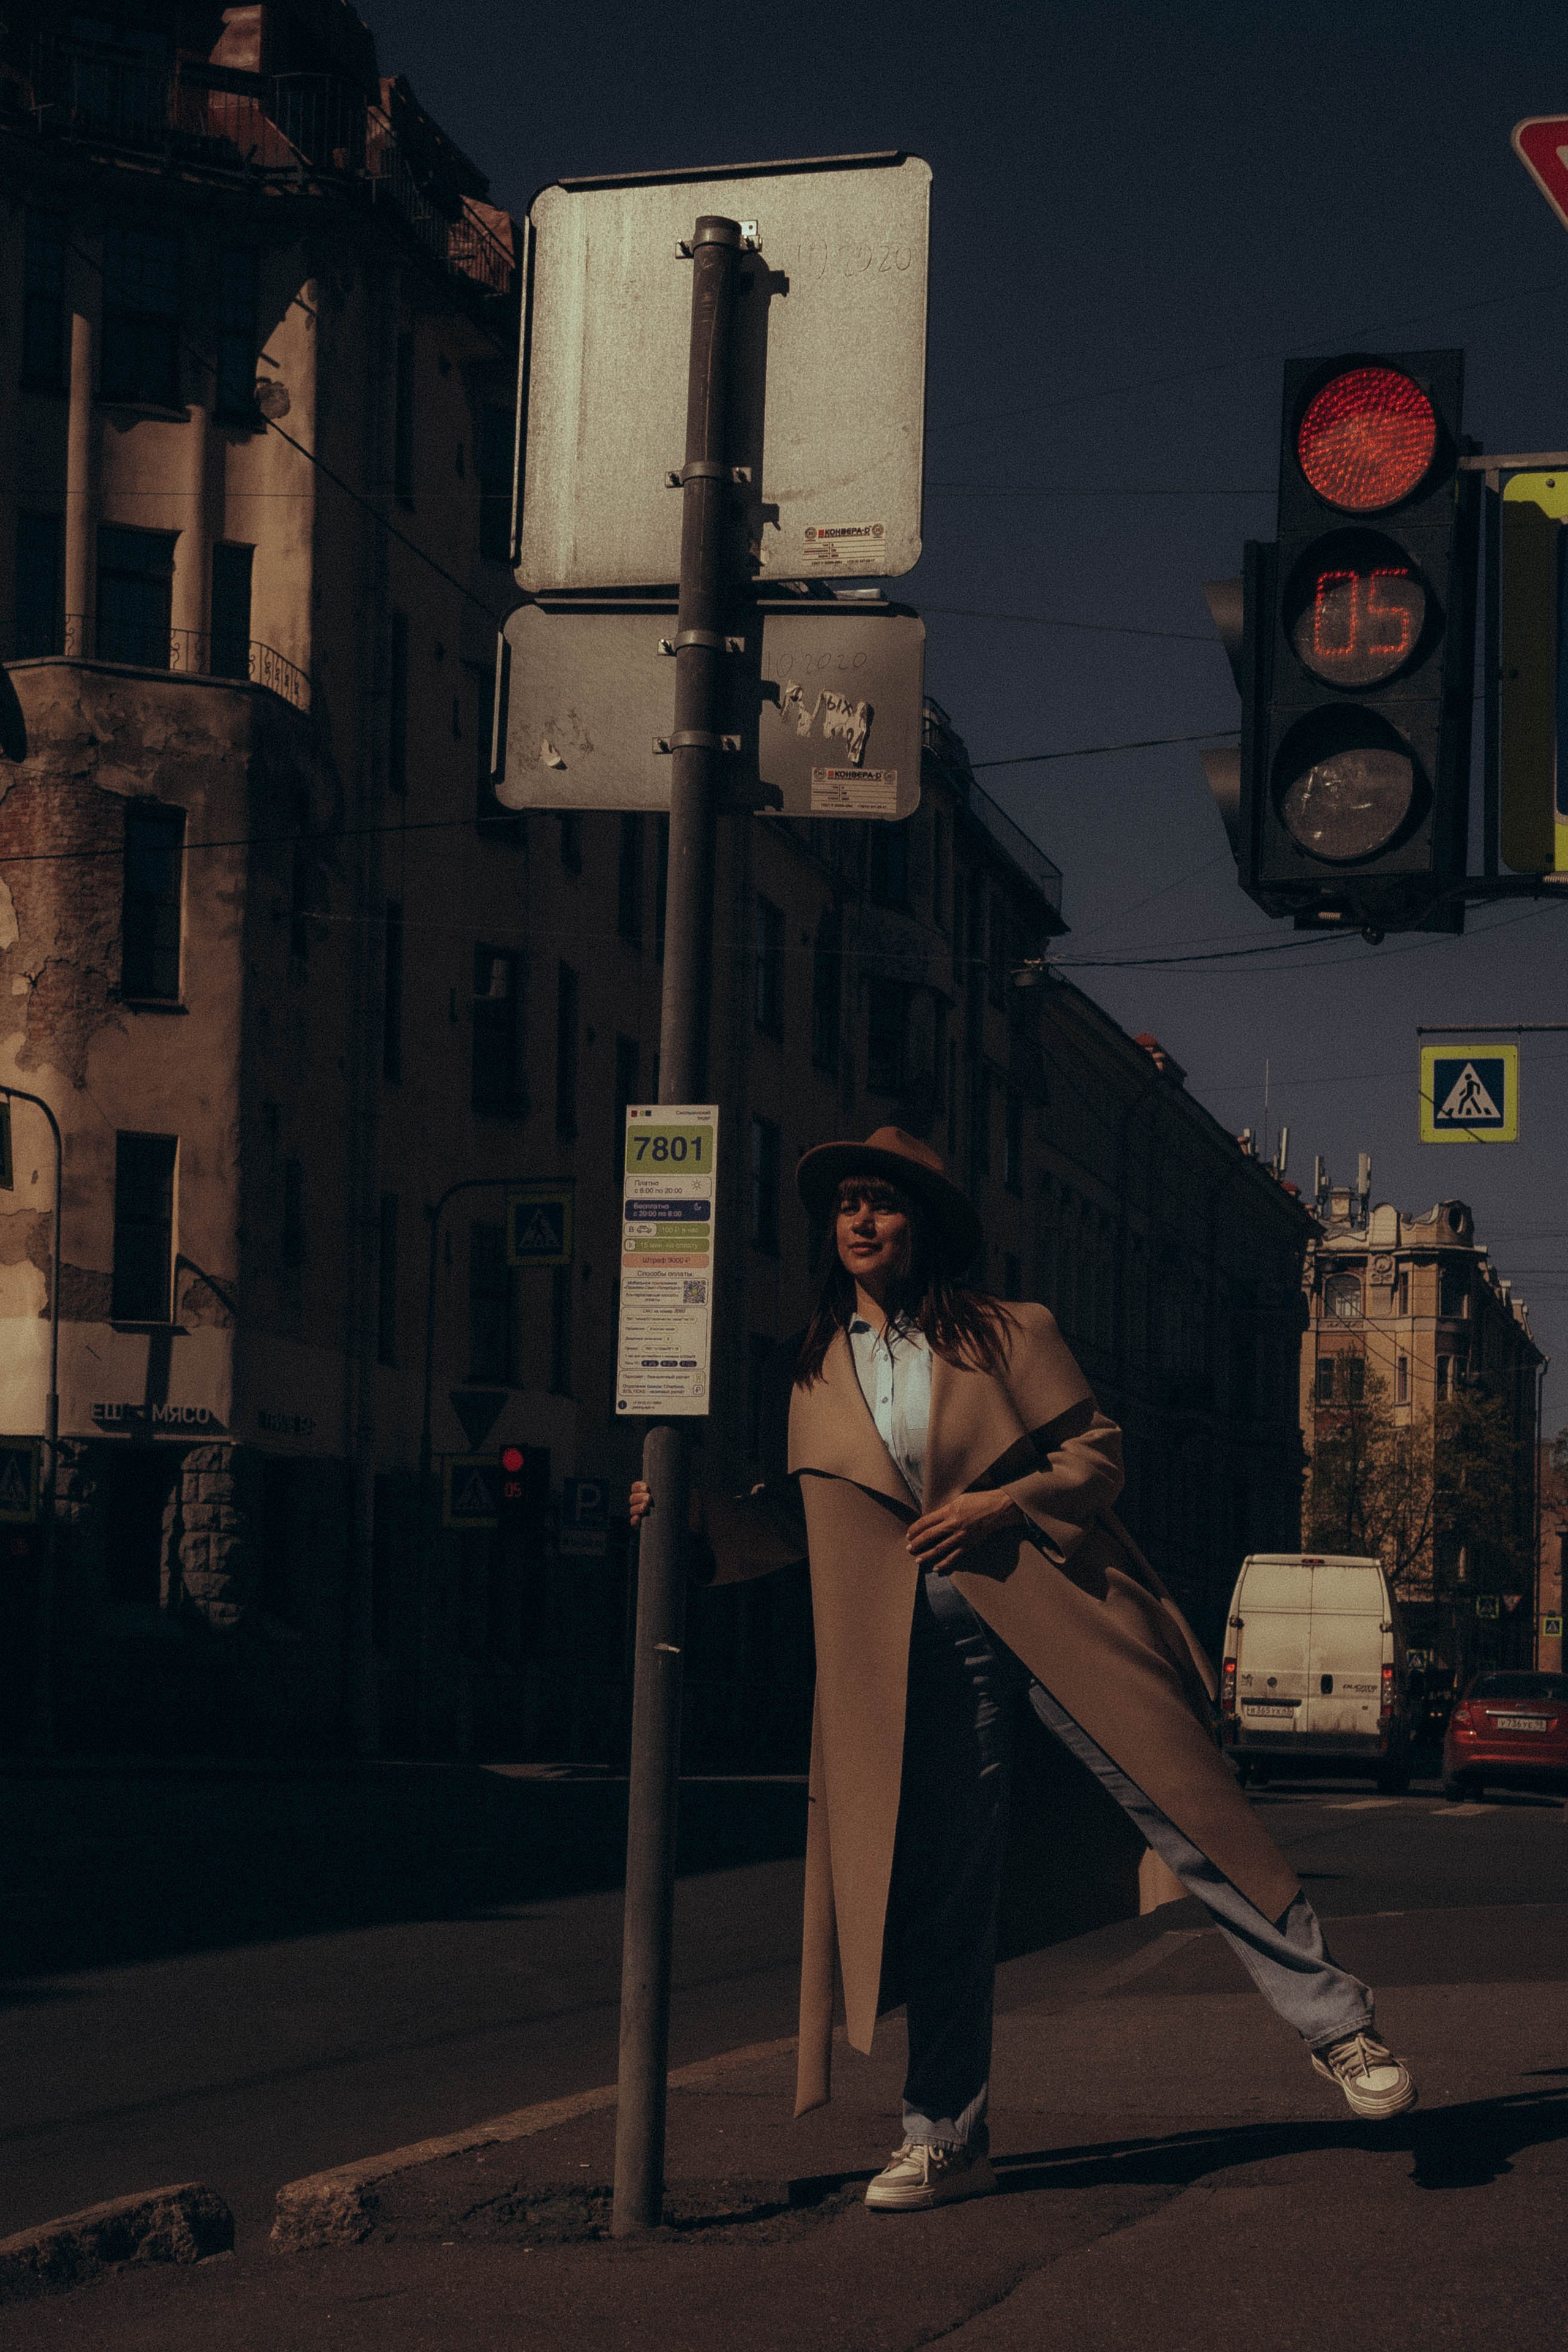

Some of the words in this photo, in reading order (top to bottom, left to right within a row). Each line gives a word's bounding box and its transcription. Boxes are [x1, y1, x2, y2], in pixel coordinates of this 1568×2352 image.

[1314, 566, 1411, 655] 05
[633, 1136, 702, 1161] 7801
[153, 1404, 211, 1425] МЯСО
[503, 1481, 522, 1499] 05
